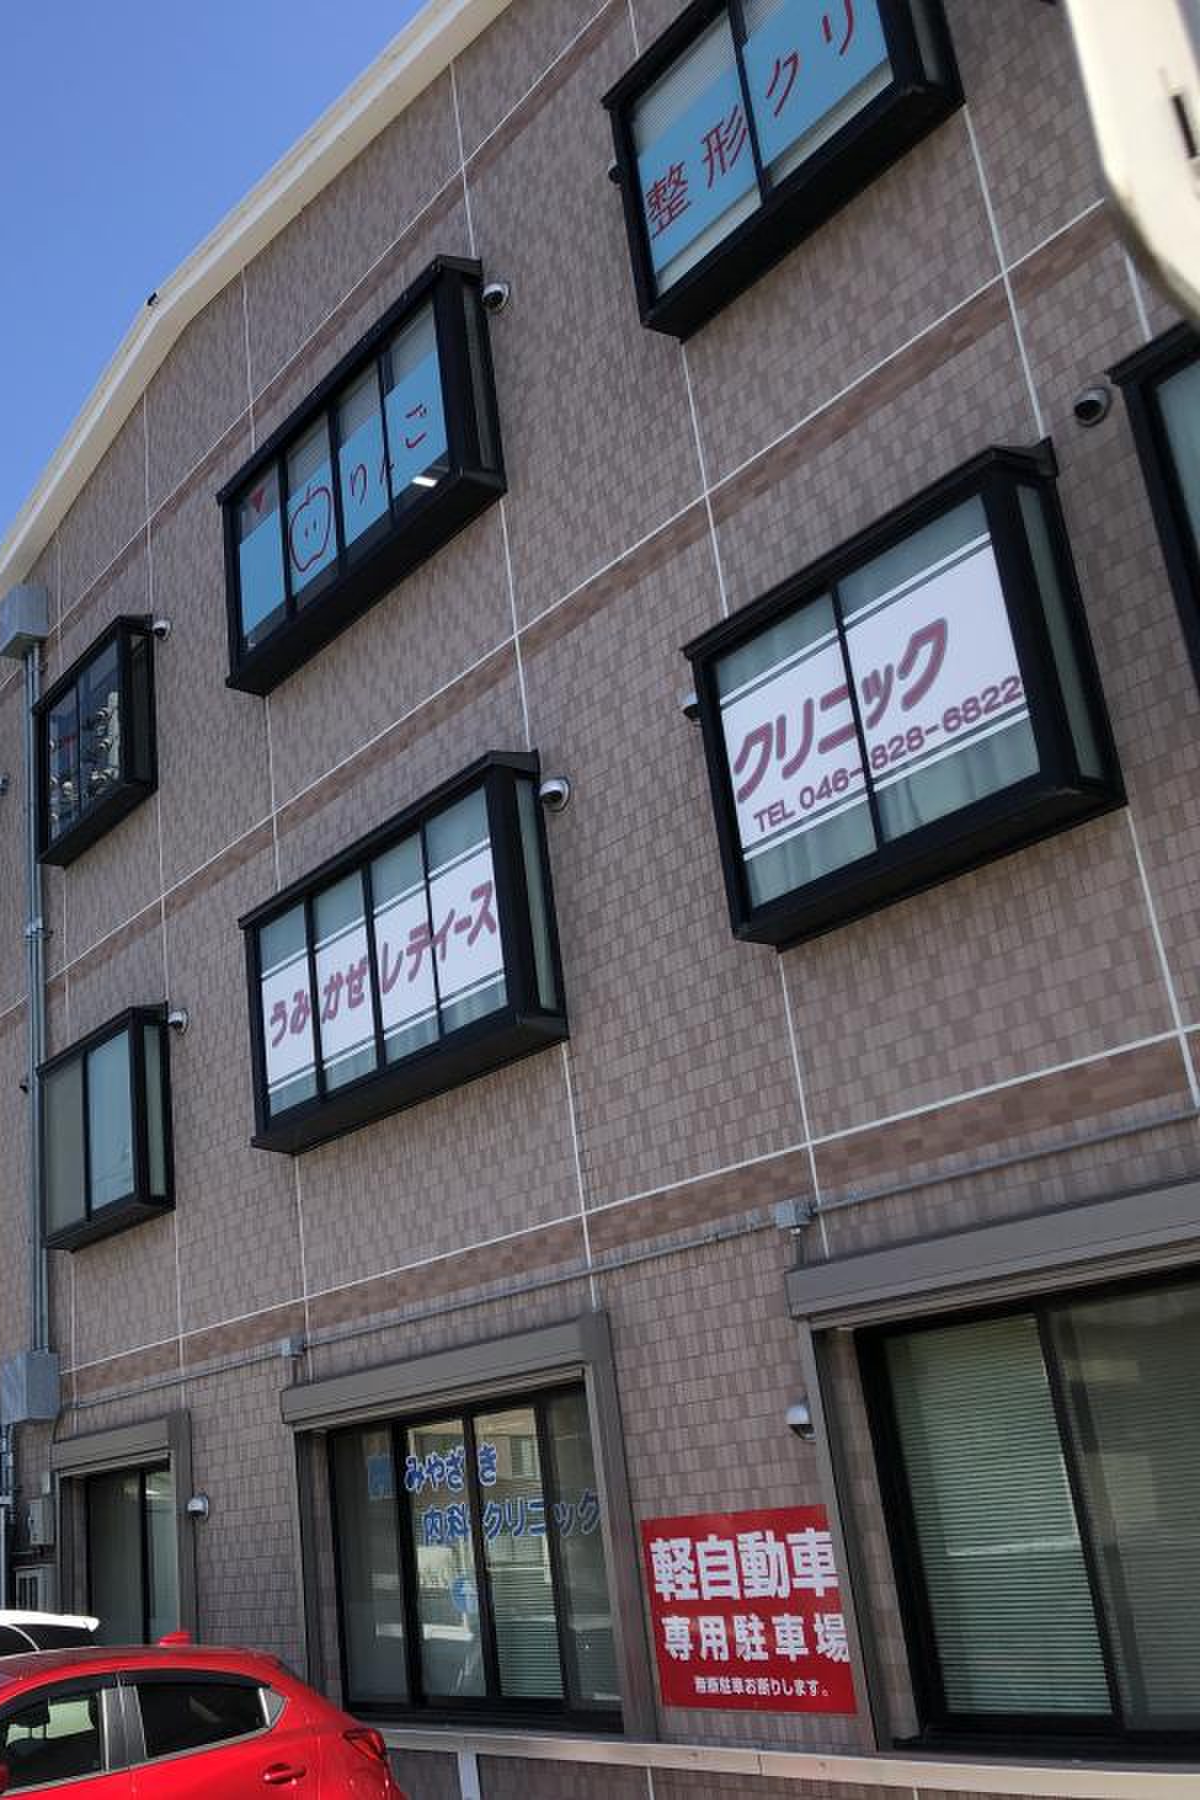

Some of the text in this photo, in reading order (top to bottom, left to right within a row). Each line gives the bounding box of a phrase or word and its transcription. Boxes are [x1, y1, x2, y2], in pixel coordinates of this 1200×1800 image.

[733, 618, 948, 802] クリニック
[753, 675, 1023, 832] TEL 046-828-6822
[404, 1442, 496, 1493] みやざき
[423, 1489, 600, 1545] 内科クリニック
[650, 1528, 838, 1602] 軽自動車
[661, 1613, 850, 1662] 専用駐車場
